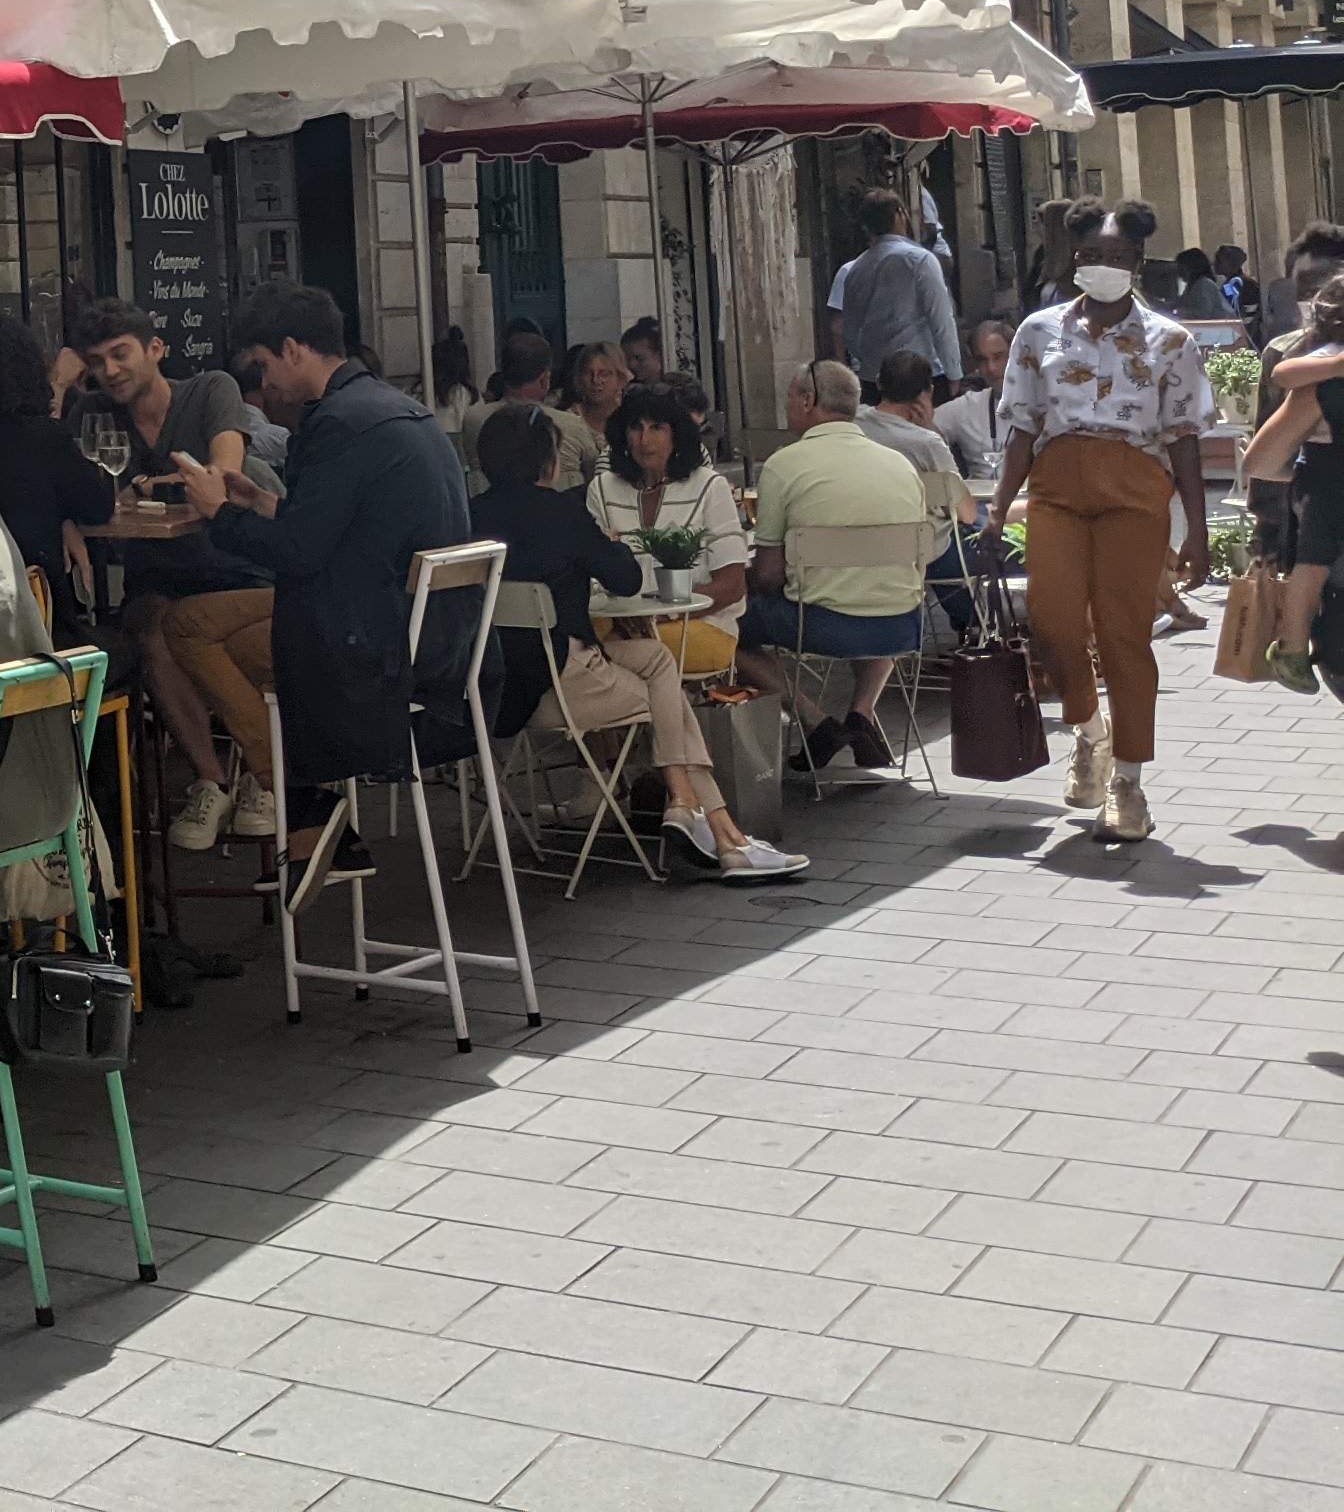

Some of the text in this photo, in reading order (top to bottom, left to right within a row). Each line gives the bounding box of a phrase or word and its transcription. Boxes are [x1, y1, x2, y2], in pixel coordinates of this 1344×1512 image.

[159, 163, 186, 182] CHEZ
[139, 182, 209, 221] Lolotte
[153, 279, 206, 300] Vins du Monde
